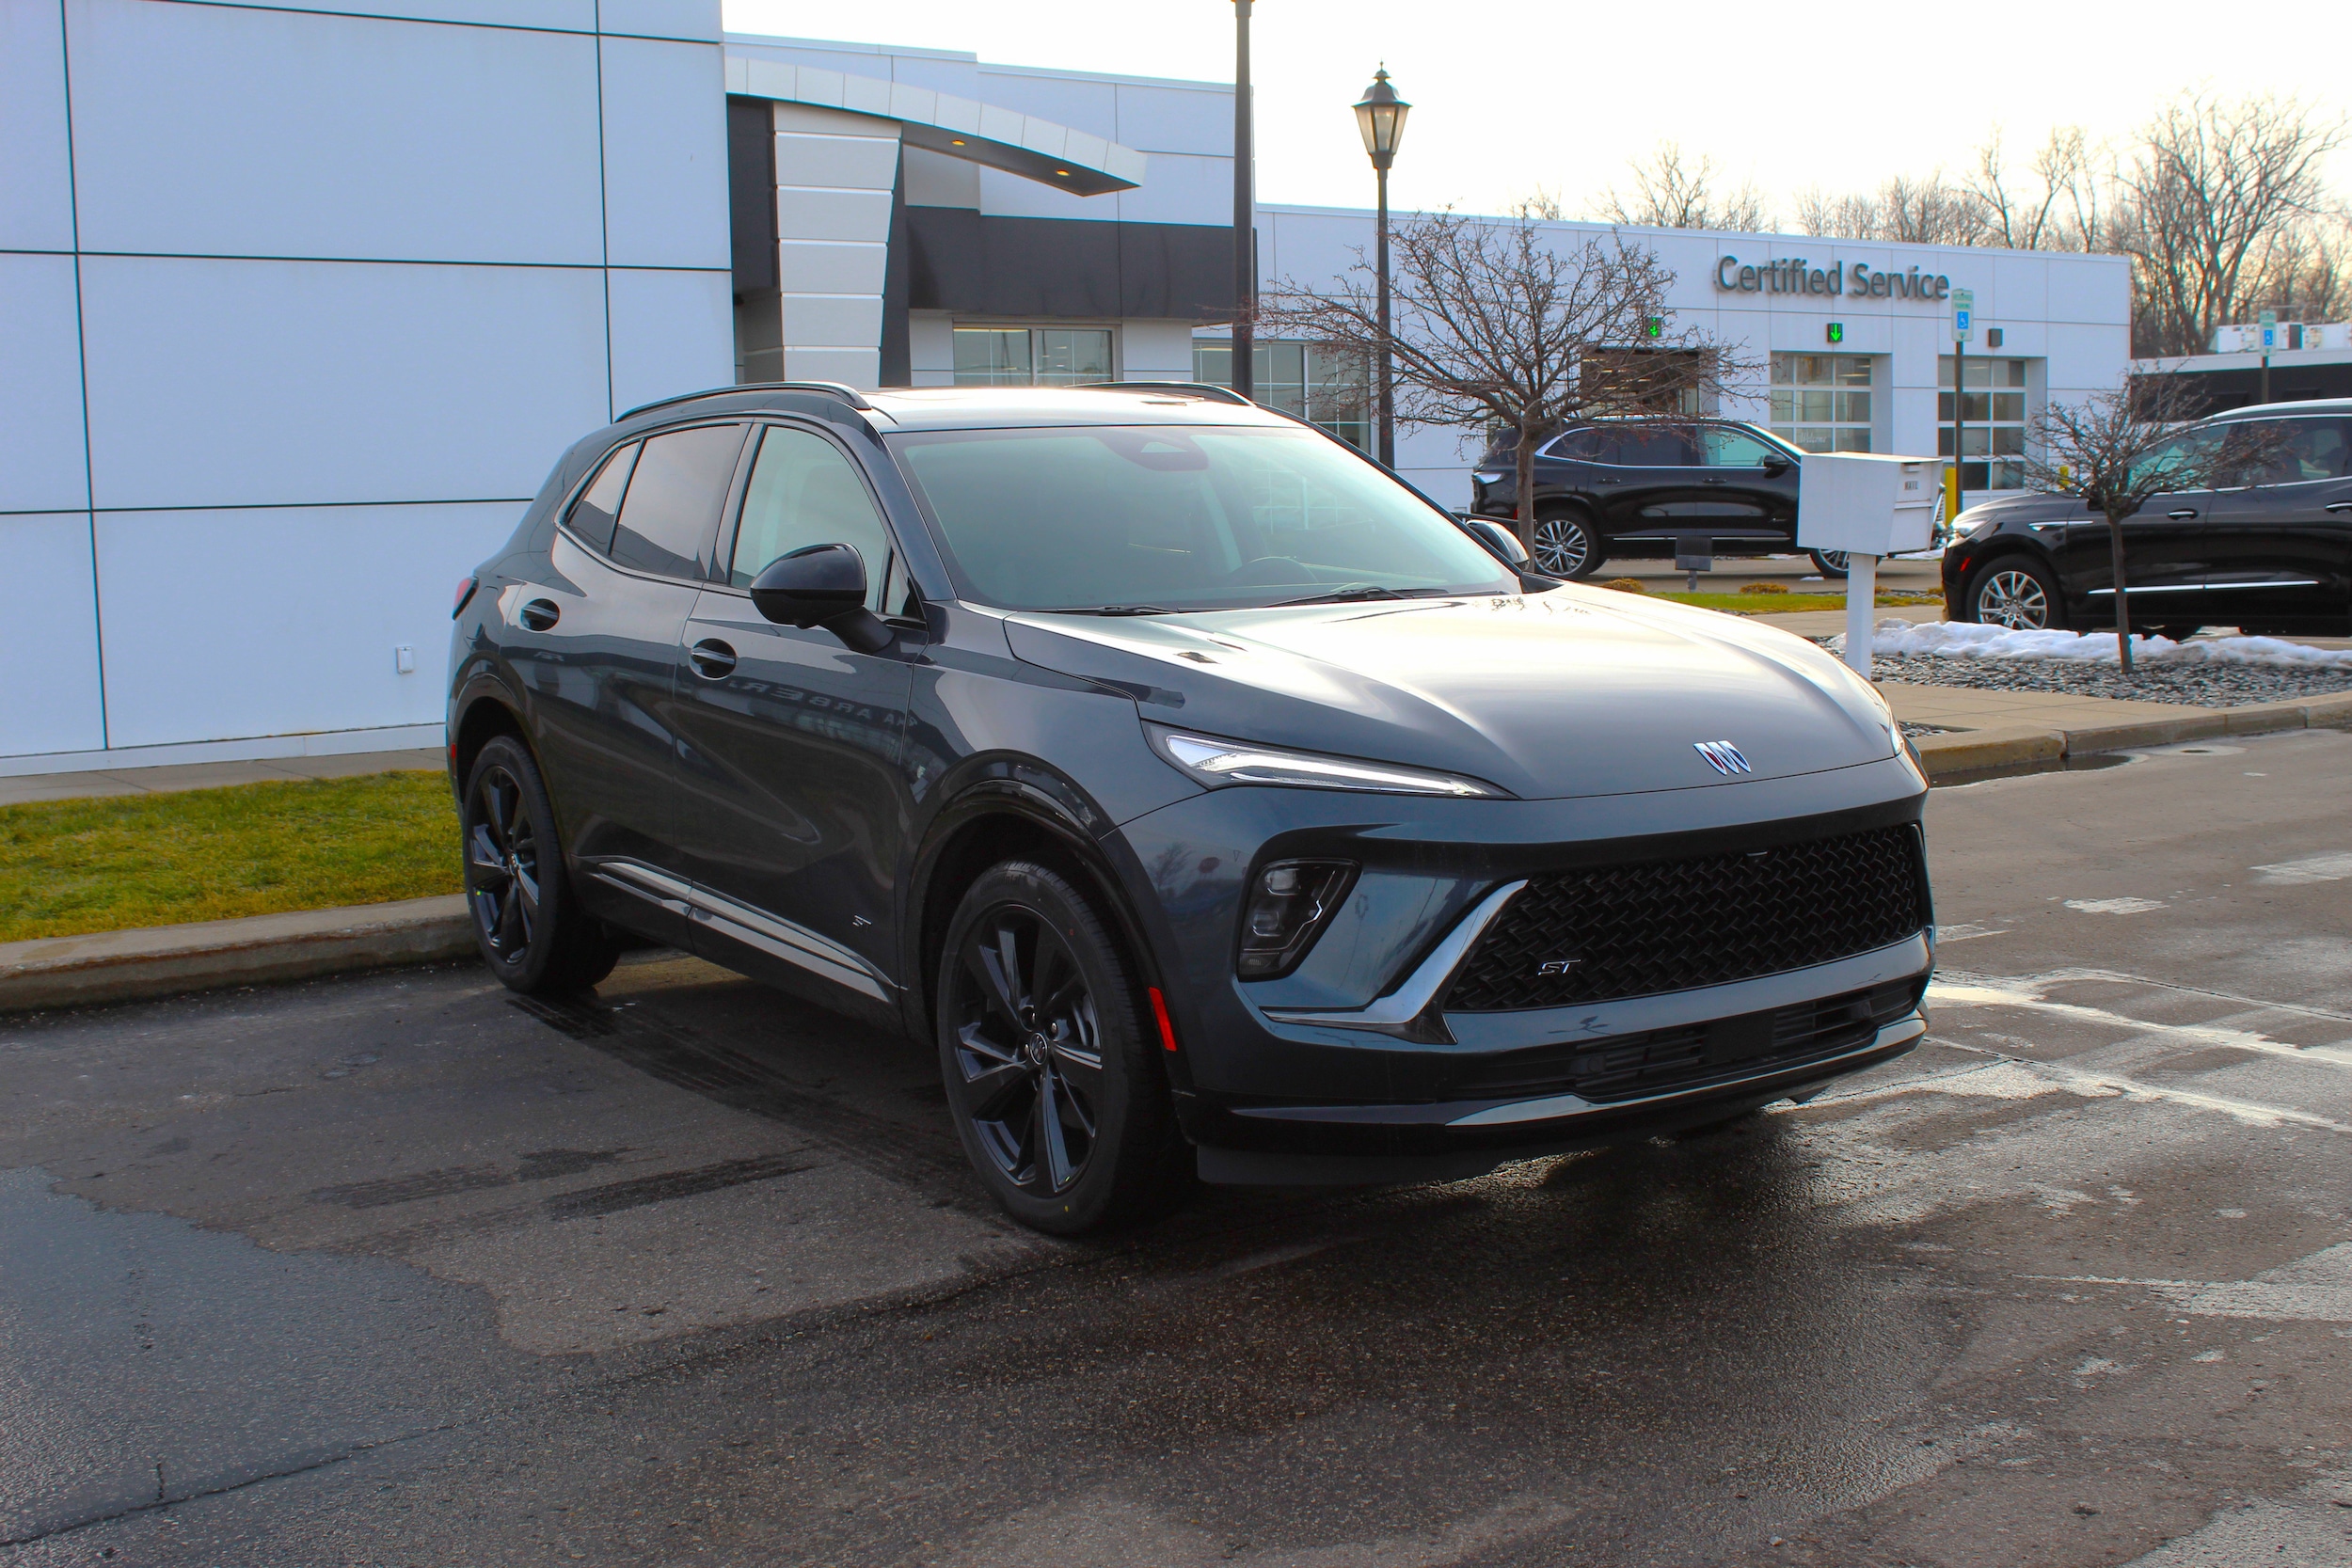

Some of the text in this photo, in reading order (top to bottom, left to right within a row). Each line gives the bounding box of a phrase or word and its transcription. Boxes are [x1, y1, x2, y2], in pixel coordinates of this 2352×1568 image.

[1715, 255, 1950, 300] Certified Service
[1537, 959, 1581, 975] ST
